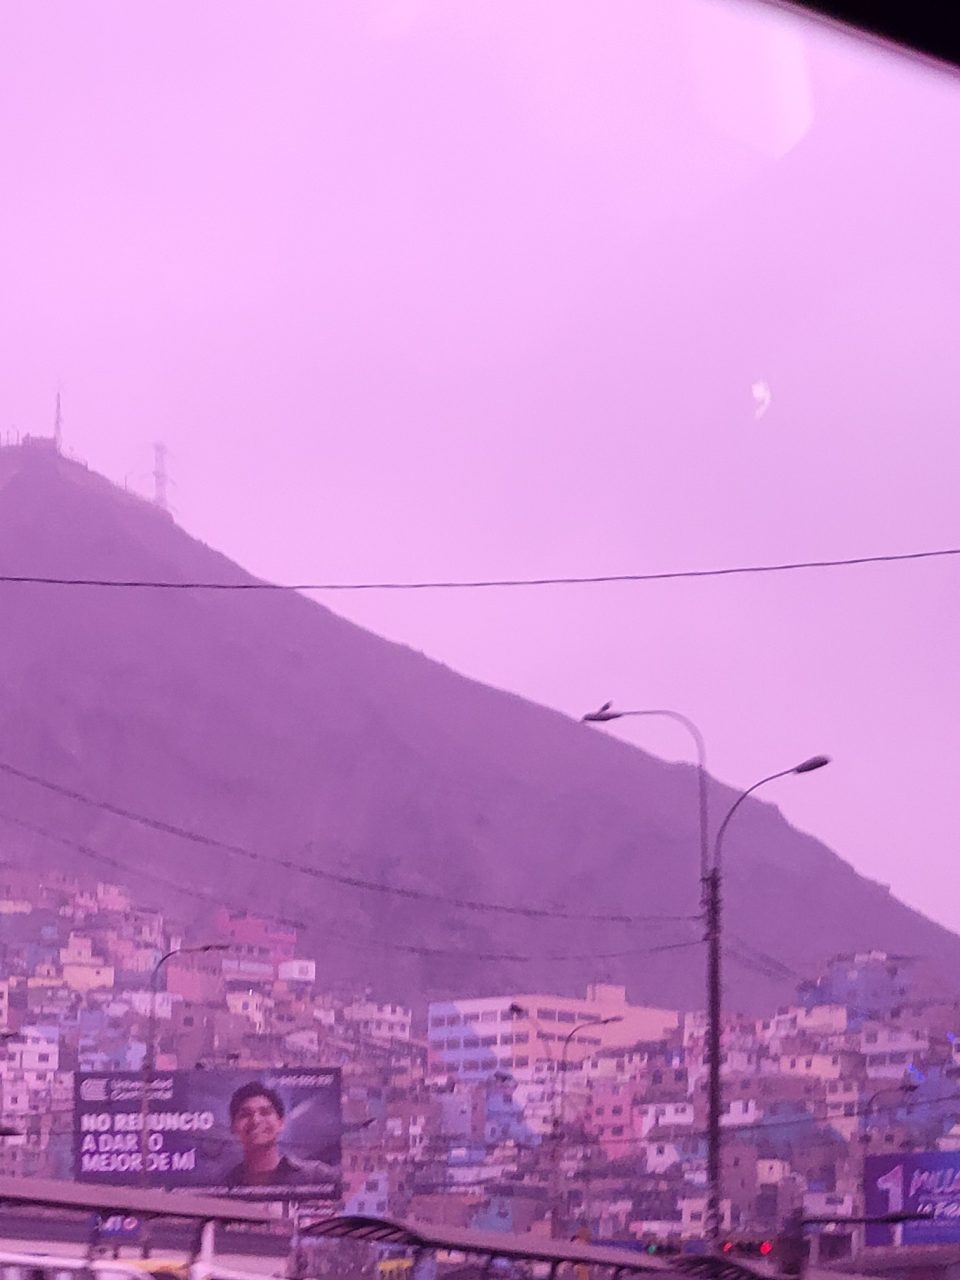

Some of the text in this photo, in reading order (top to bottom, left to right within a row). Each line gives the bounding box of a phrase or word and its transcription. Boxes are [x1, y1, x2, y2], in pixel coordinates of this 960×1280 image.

[81, 1112, 112, 1132] NO
[81, 1133, 97, 1153] A
[98, 1133, 139, 1152] DAR
[81, 1152, 143, 1172] MEJOR
